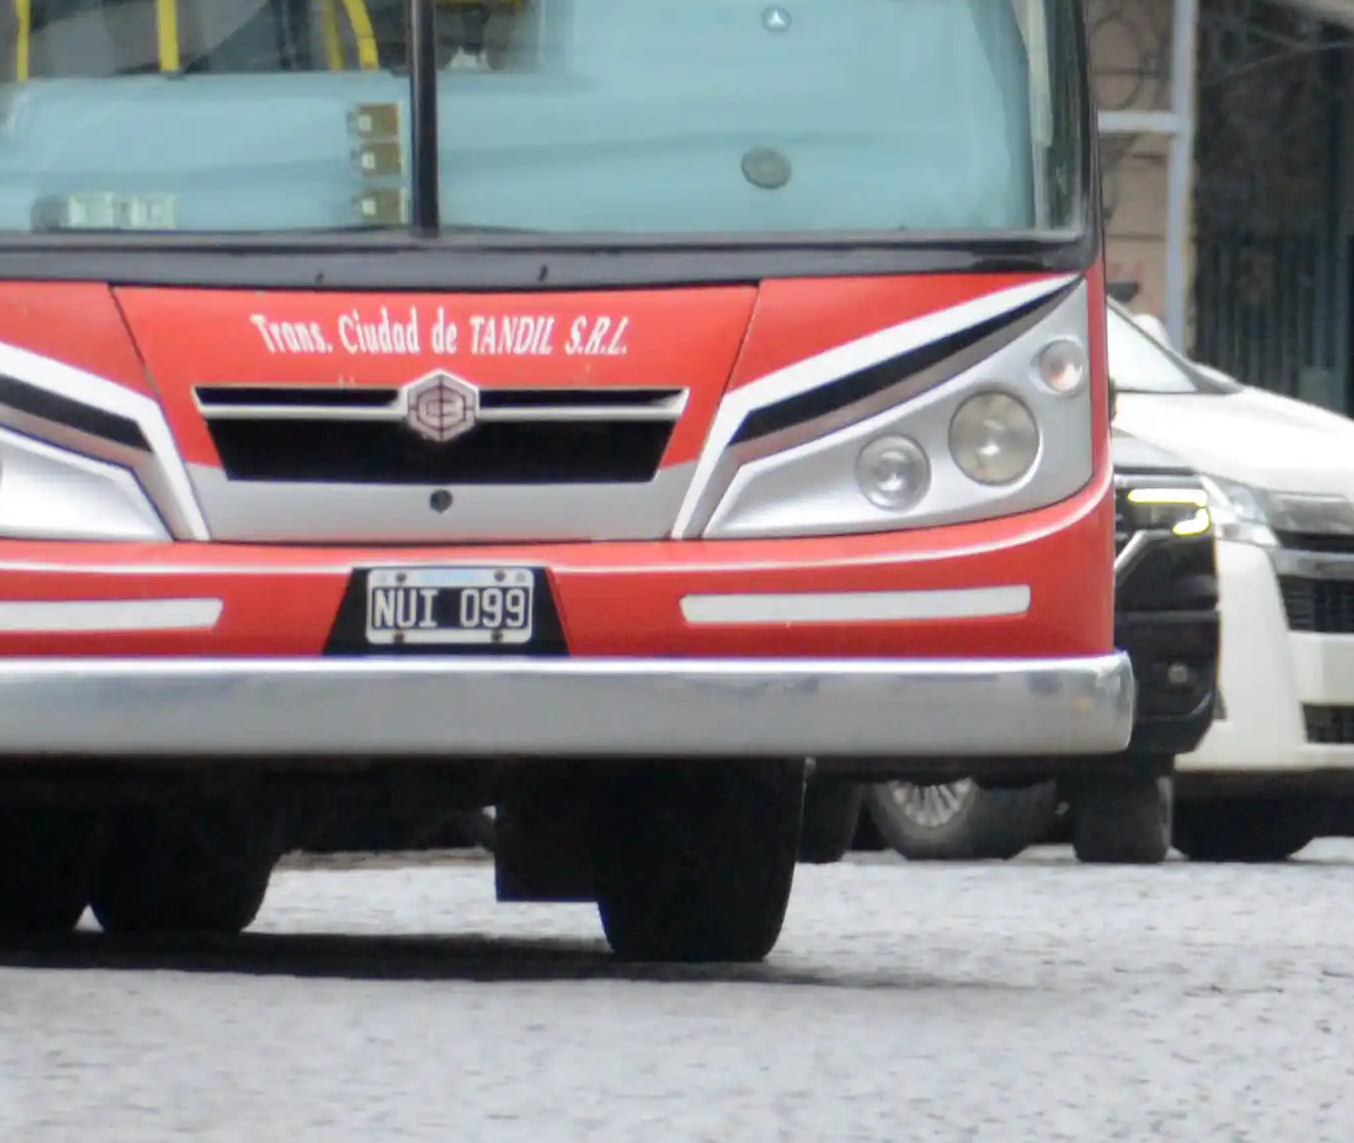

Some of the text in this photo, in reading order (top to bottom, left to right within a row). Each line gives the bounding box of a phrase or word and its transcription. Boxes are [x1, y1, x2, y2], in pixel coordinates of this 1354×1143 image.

[250, 307, 628, 355] Trans. Ciudad de TANDIL S.R.L.
[375, 589, 525, 628] NUI 099
